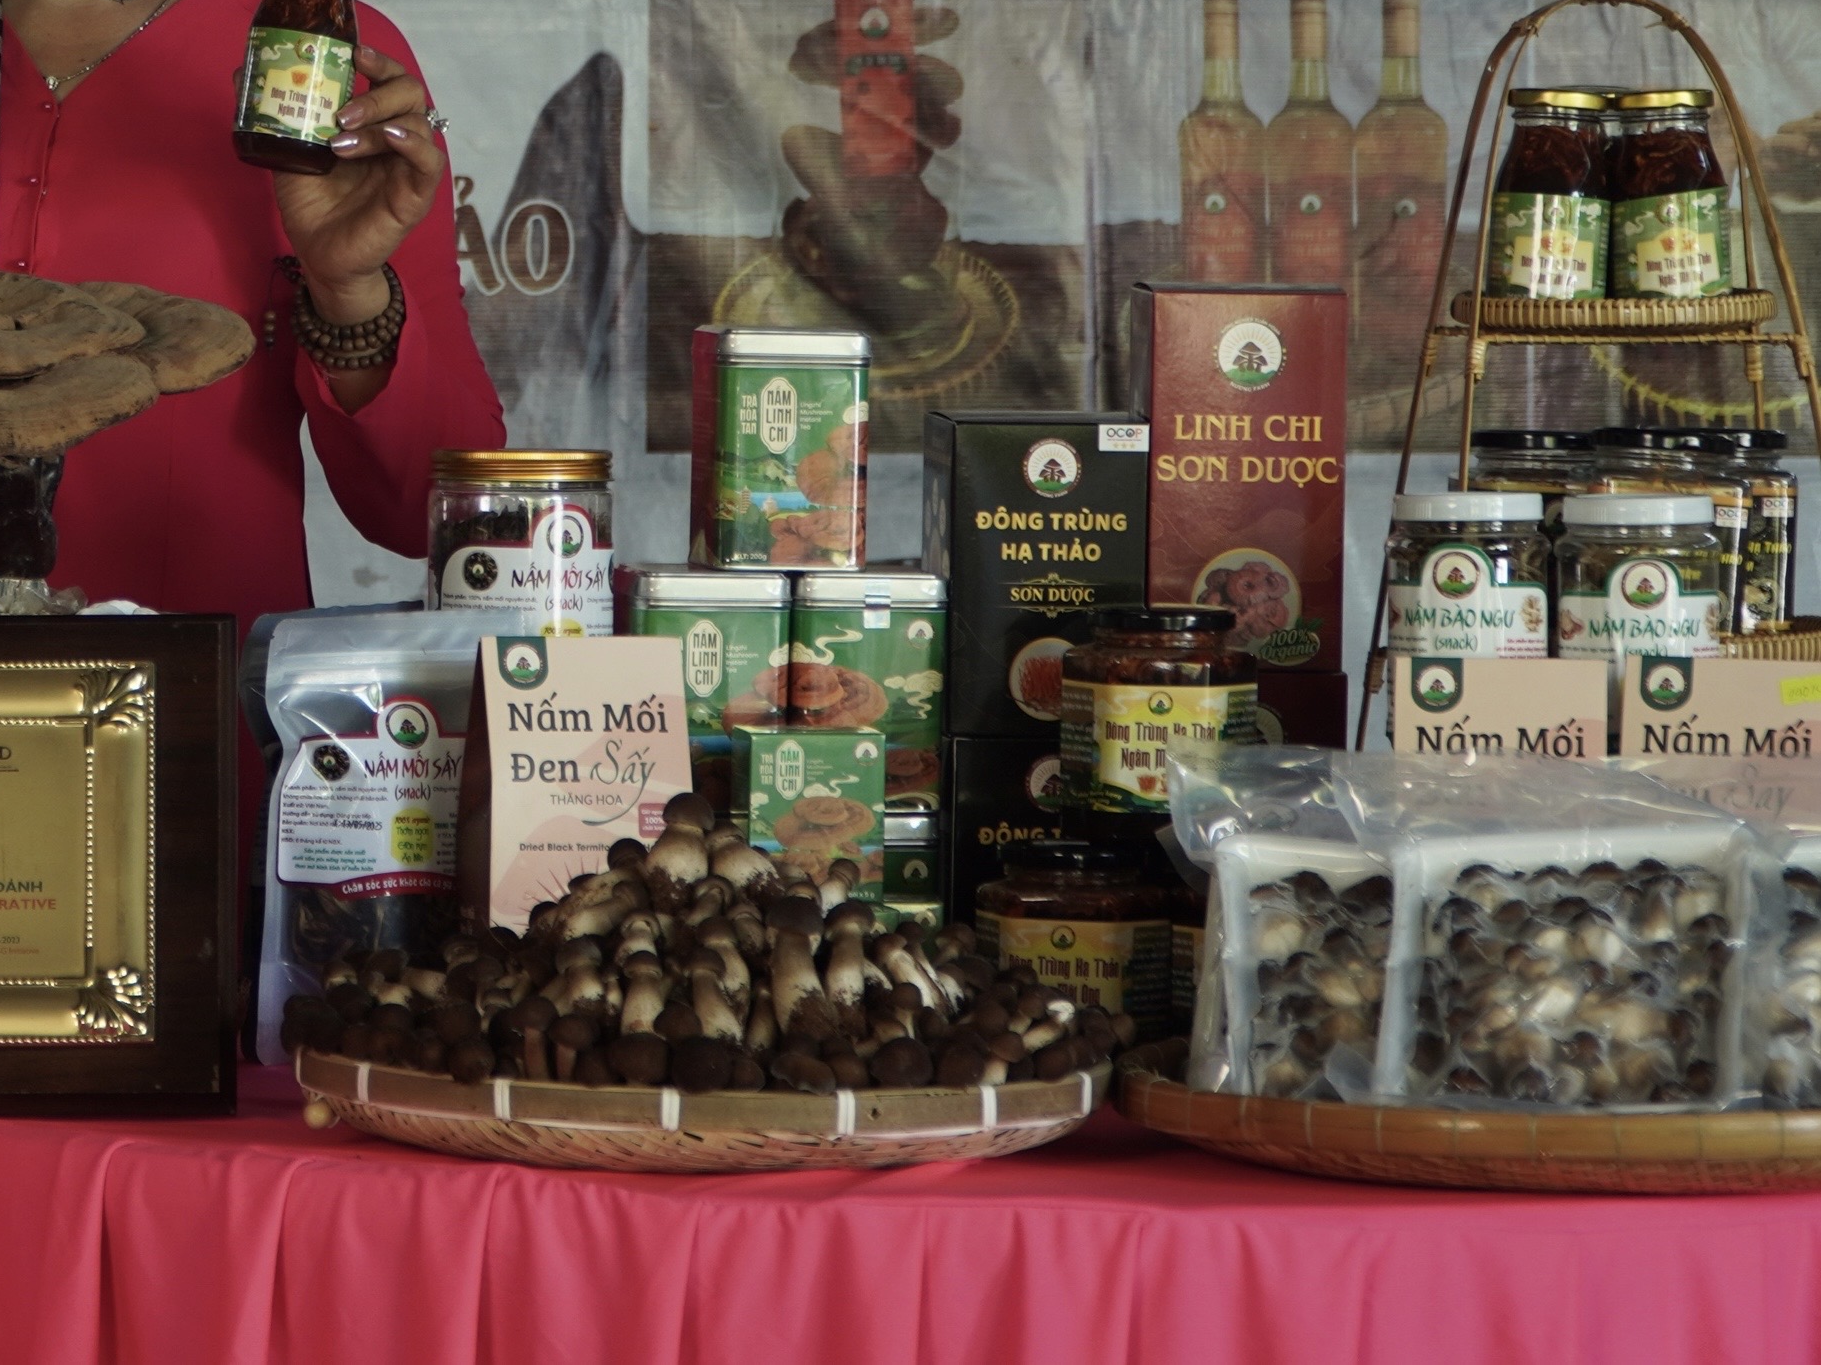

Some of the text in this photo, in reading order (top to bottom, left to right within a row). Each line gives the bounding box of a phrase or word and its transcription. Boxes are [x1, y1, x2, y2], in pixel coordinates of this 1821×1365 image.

[1106, 427, 1143, 438] OCOP
[1174, 414, 1322, 442] LINH CHI
[1156, 455, 1339, 488] SƠN DƯỢC
[976, 506, 1127, 531] ĐÔNG TRÙNG
[1001, 538, 1101, 564] HẠ THẢO
[511, 561, 550, 591] NẤM
[545, 594, 583, 611] (sack)
[1011, 587, 1094, 605] SƠN DƯỢC
[1433, 634, 1478, 652] (snack)
[507, 692, 668, 733] Nấm Mối
[1416, 715, 1586, 758] Nấm Mối
[1642, 714, 1812, 758] Nấm Mối
[364, 751, 461, 781] NẤM MỐI SẤY
[511, 753, 580, 783] Đen
[395, 782, 430, 801] (snack)
[550, 792, 623, 806] THĂNG HOA
[519, 842, 574, 852] Dried Black
